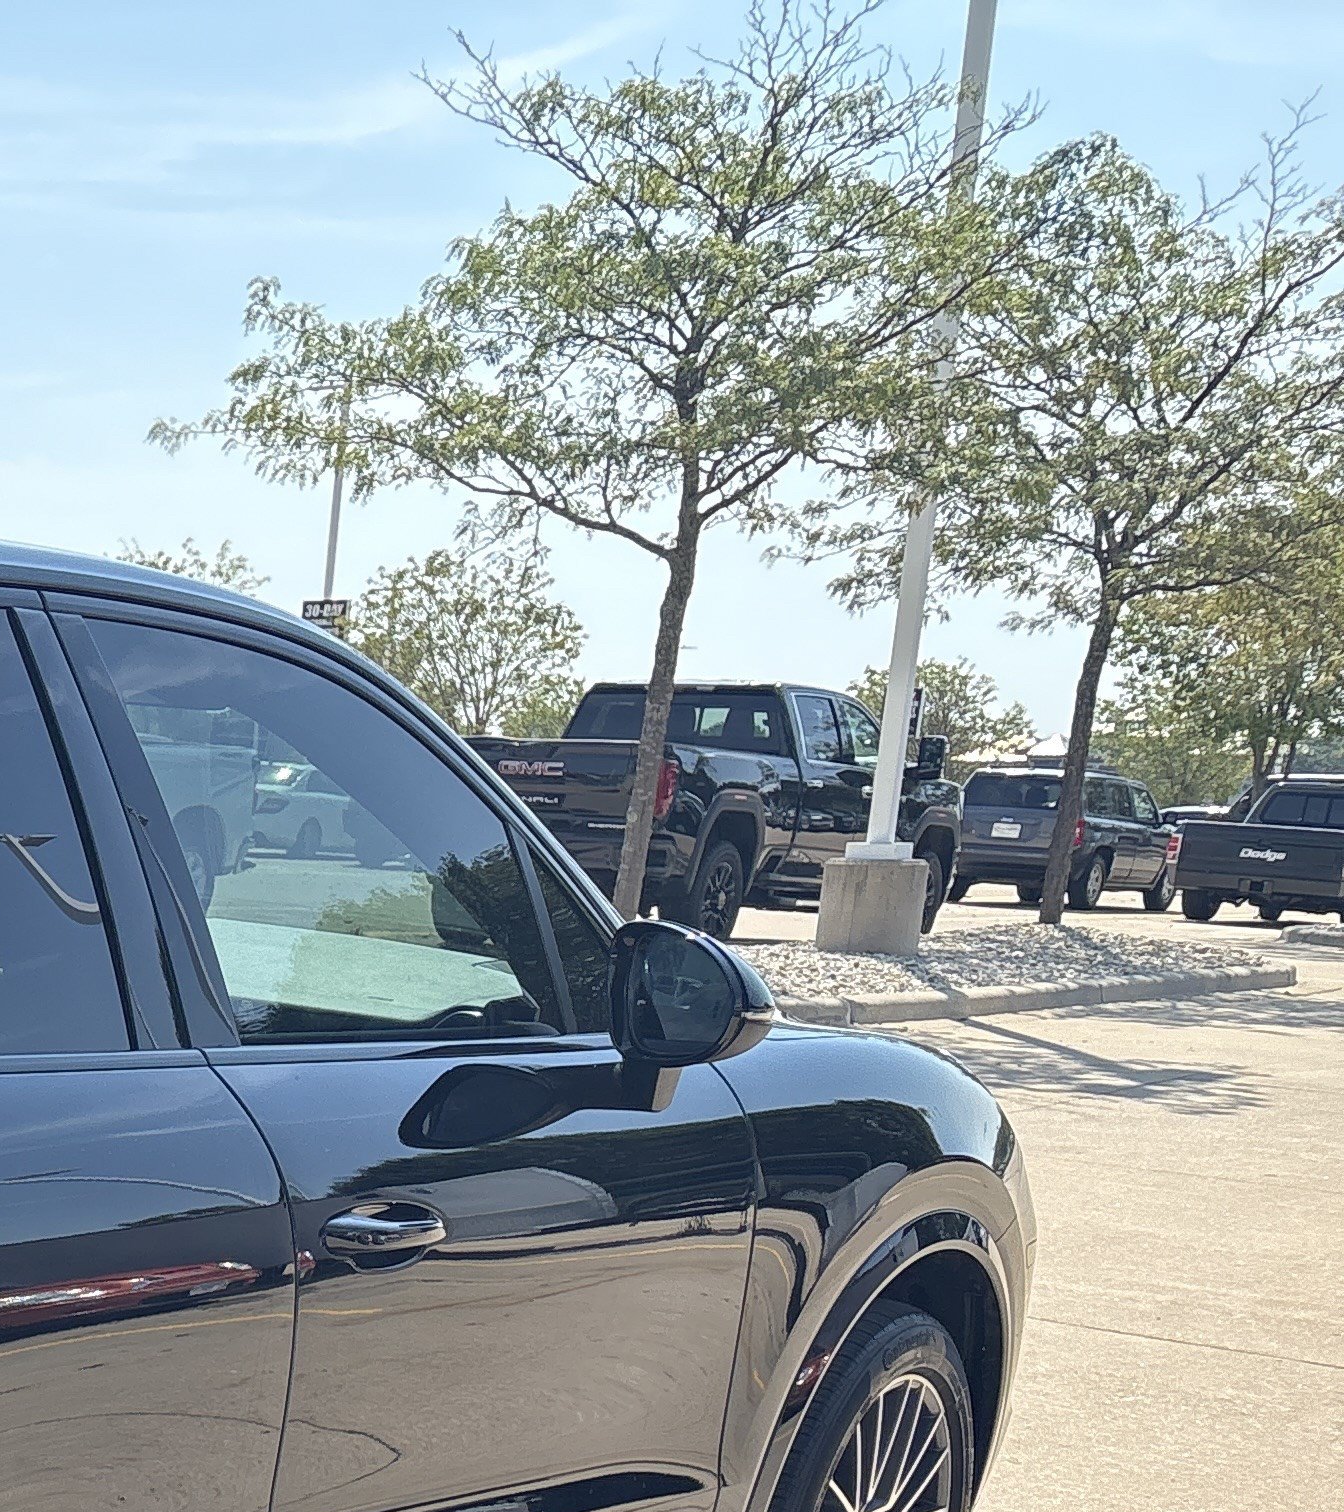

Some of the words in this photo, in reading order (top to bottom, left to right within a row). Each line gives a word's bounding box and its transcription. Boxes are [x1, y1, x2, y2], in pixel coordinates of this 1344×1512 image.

[498, 760, 565, 777] GMC
[520, 795, 559, 804] NALI
[1239, 847, 1287, 862] Dodge
